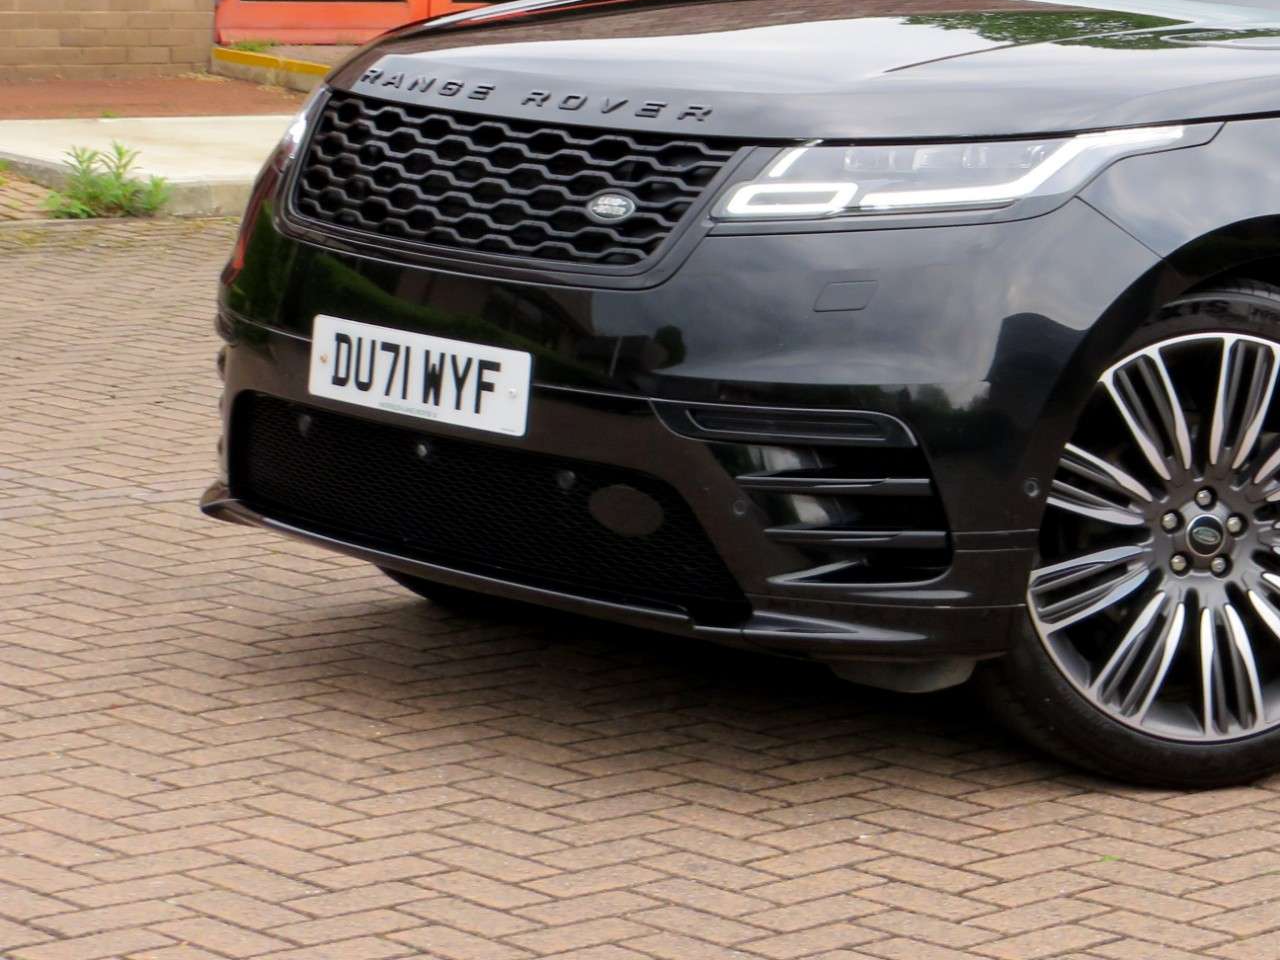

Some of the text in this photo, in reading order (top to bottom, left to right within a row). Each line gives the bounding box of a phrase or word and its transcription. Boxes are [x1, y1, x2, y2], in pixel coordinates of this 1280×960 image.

[359, 68, 713, 123] RANGE ROVER
[331, 332, 502, 414] DU71 WYF
